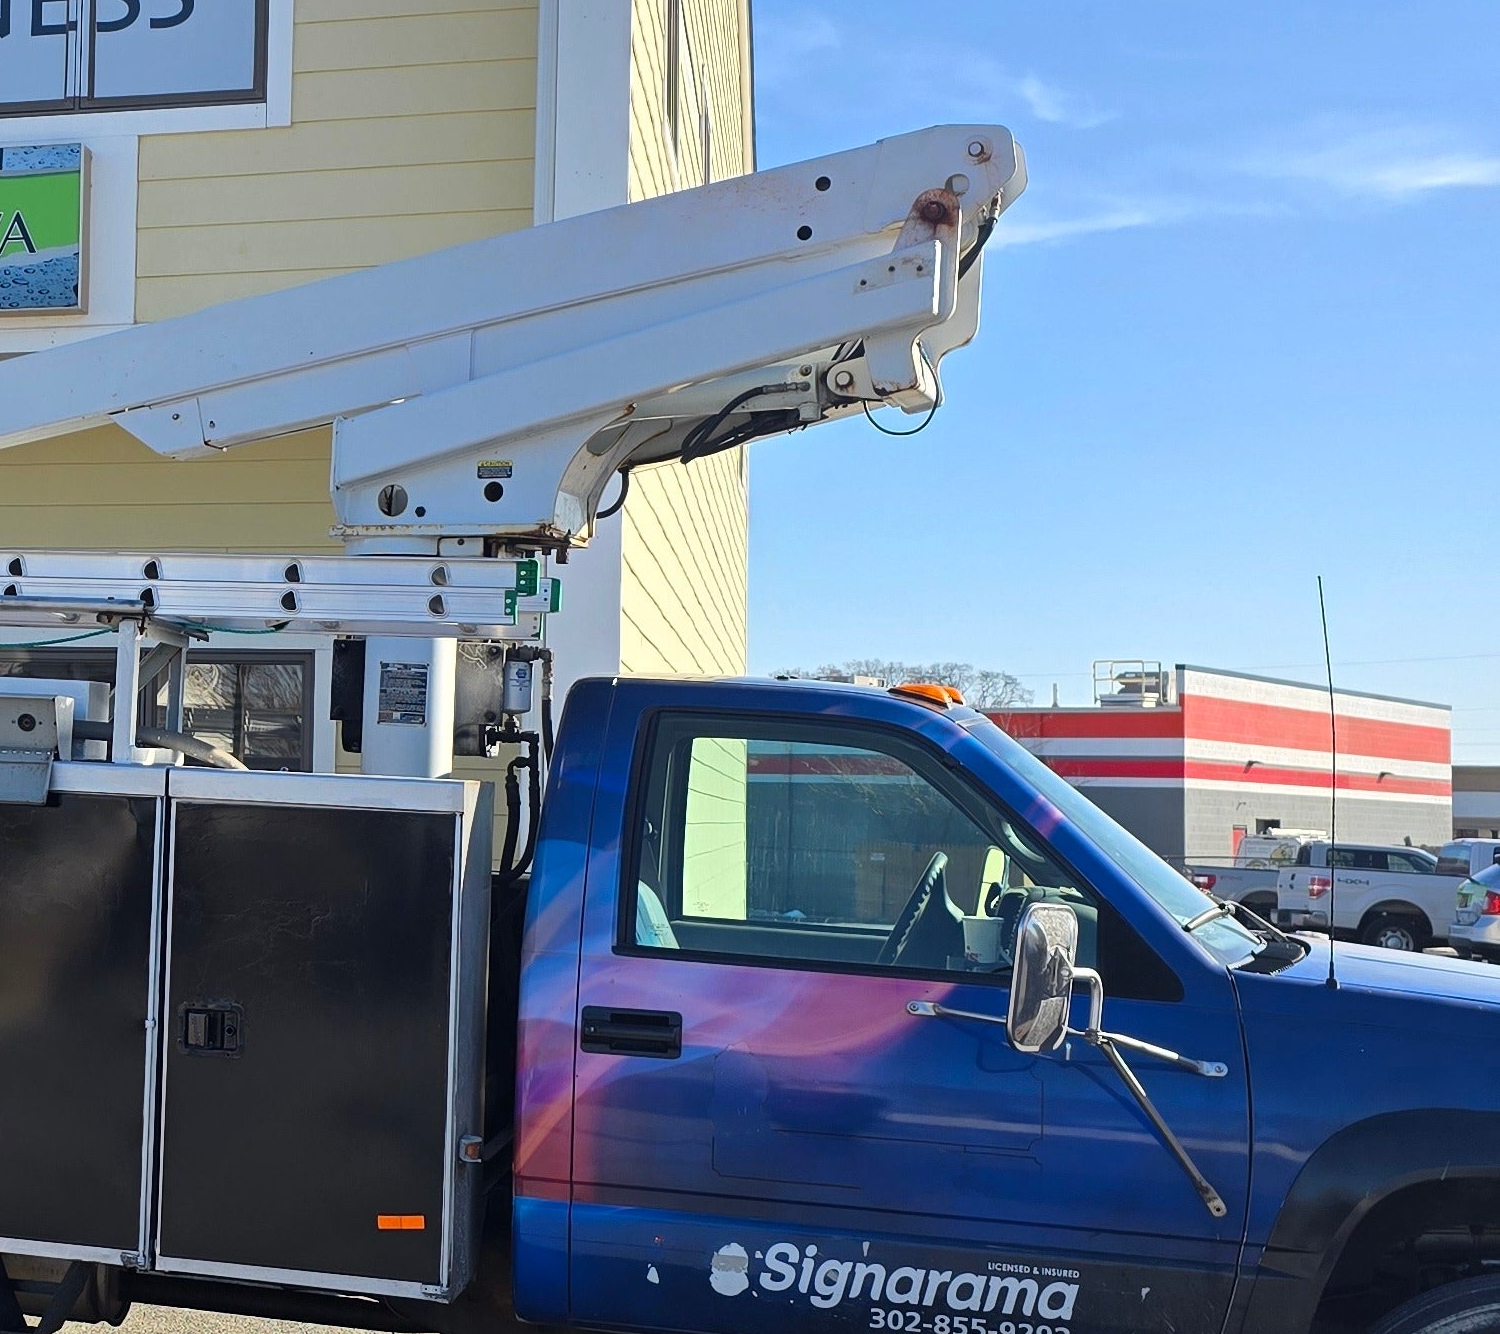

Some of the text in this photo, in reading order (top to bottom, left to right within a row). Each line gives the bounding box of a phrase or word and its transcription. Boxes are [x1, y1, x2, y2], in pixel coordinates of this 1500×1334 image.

[759, 1242, 1080, 1322] Signarama
[987, 1261, 1080, 1279] LICENSED & INSURED
